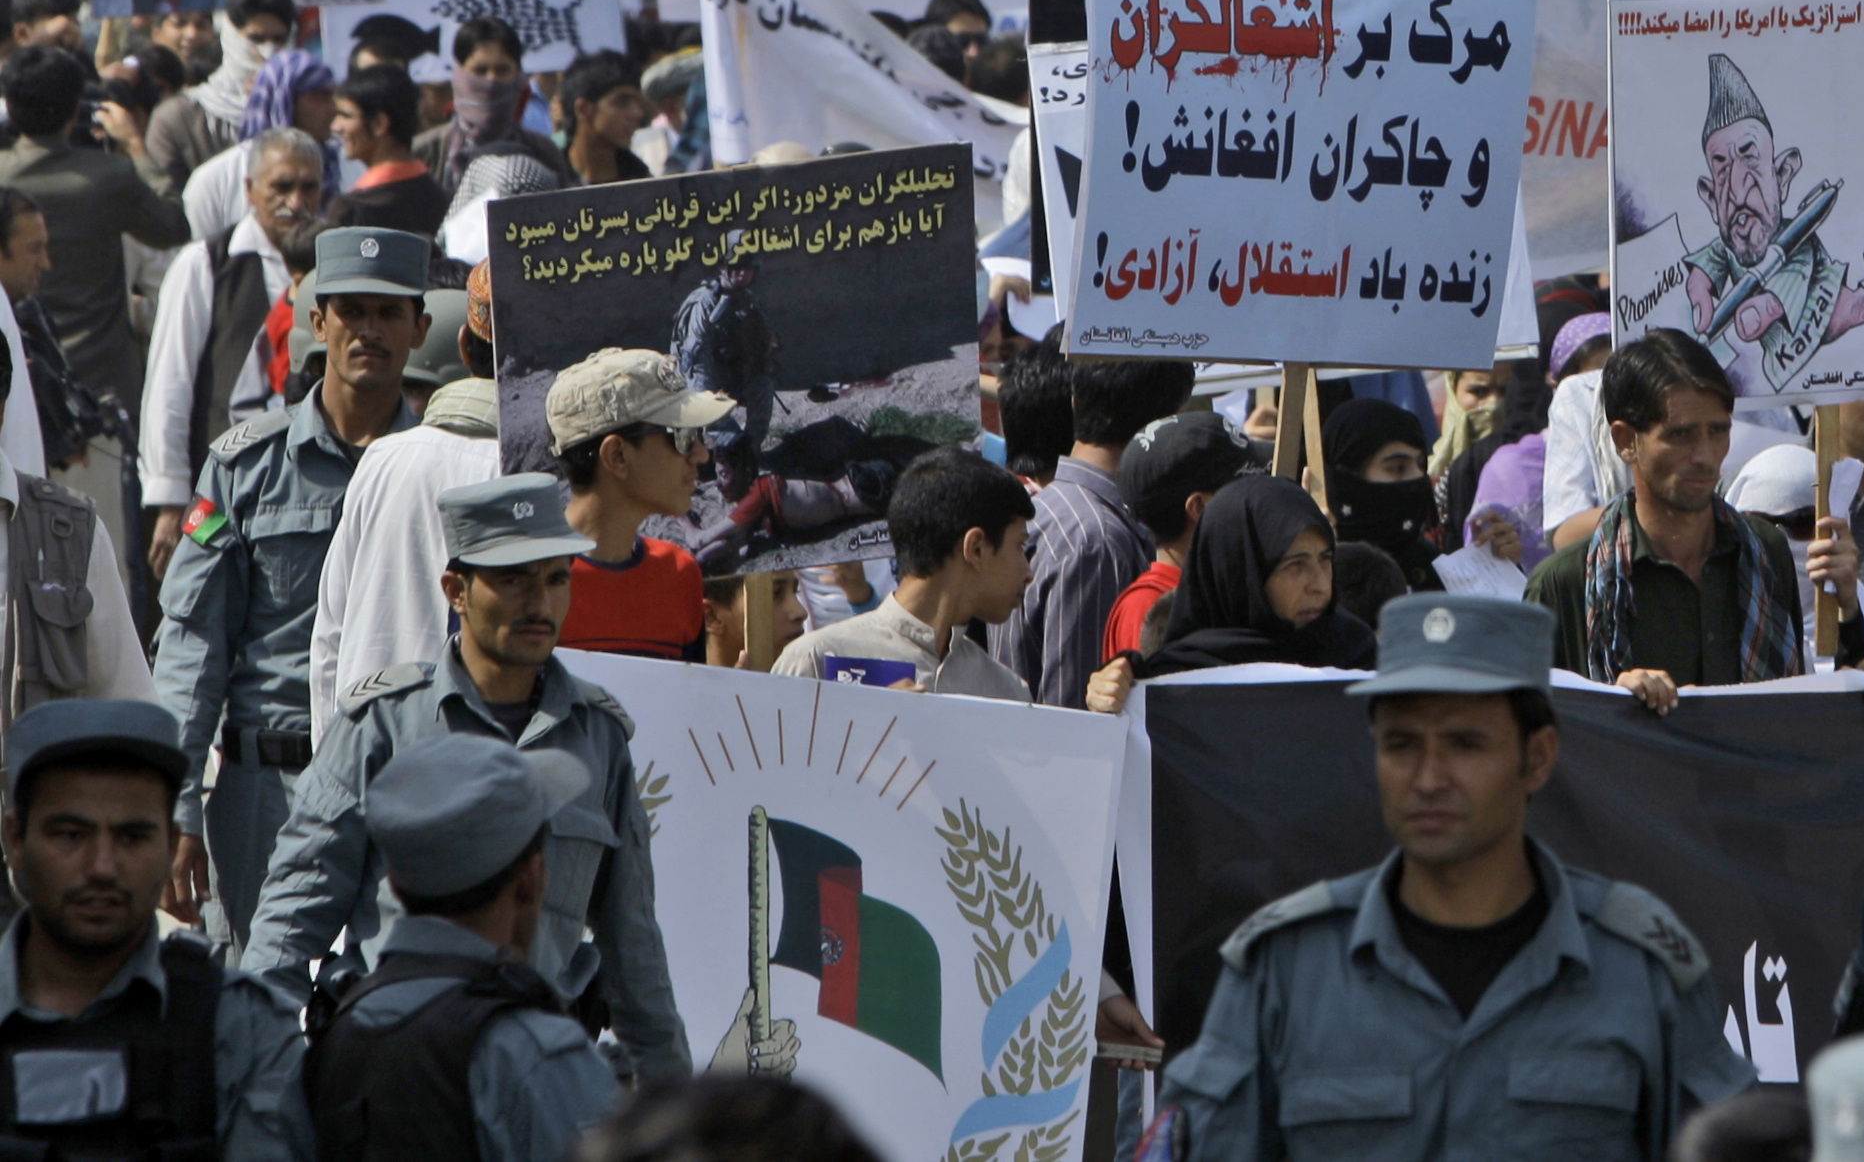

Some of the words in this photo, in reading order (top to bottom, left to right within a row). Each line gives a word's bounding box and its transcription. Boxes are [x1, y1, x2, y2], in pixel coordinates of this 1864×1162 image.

[1683, 10, 1717, 33] امضا
[1718, 10, 1731, 38] را
[1735, 6, 1776, 35] امریکا
[1777, 5, 1788, 28] با
[1791, 1, 1861, 33] استراتژیک
[1343, 12, 1393, 80] بر
[1122, 100, 1296, 193] افغانش!
[1309, 113, 1452, 211] چاکران
[857, 164, 956, 206] تحلیلگران
[1461, 137, 1491, 208] و
[635, 191, 700, 229] قربانی
[706, 191, 741, 225] این
[917, 202, 946, 238] آیا
[505, 220, 556, 249] میبود
[805, 219, 852, 254] برای
[618, 240, 658, 275] پاره
[1092, 228, 1201, 305] آزادی!
[1208, 240, 1351, 307] استقلال،
[1359, 246, 1407, 314] باد
[1418, 249, 1492, 317] زنده
[1617, 261, 1684, 332] Promises
[1080, 326, 1132, 346] افغانستان
[1181, 333, 1209, 349] حزب
[1775, 285, 1834, 370] Karzai
[1802, 371, 1842, 389] افغانستان
